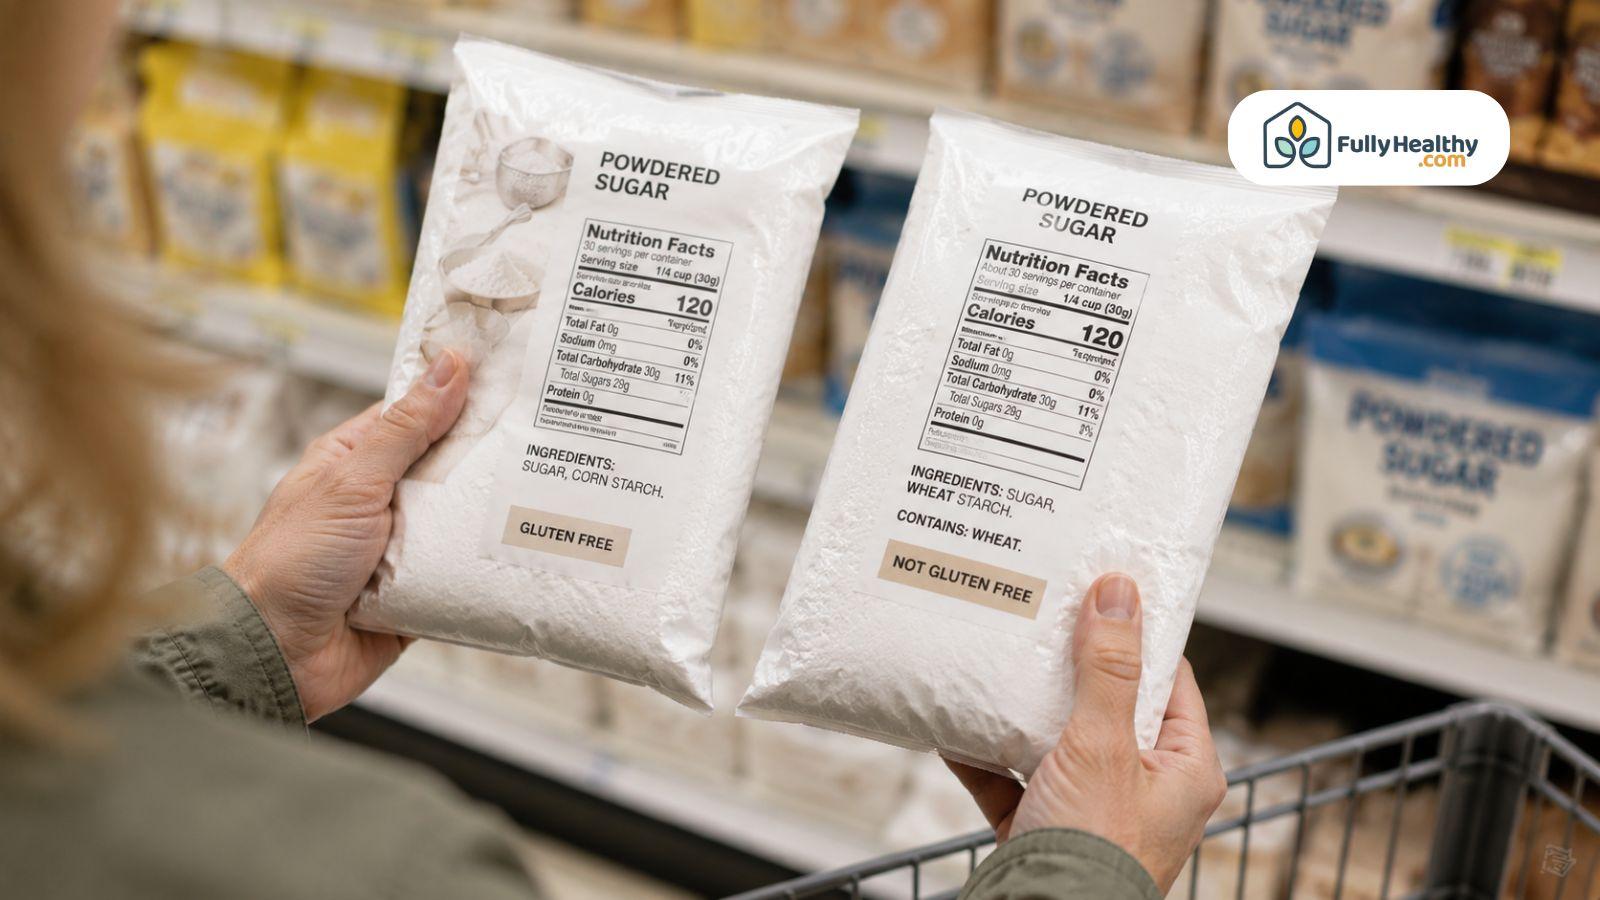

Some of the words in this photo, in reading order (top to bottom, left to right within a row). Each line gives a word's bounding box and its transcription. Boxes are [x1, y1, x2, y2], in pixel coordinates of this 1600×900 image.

[600, 151, 720, 185] POWDERED
[595, 174, 670, 200] SUGAR
[1022, 188, 1149, 228] POWDERED
[587, 223, 662, 249] Nutrition
[667, 237, 715, 258] Facts
[1039, 213, 1117, 243] SUGAR
[581, 254, 616, 270] Serving
[619, 262, 638, 272] size
[656, 266, 671, 277] 1/4
[674, 271, 692, 281] cup
[694, 273, 720, 287] (30g)
[583, 240, 595, 251] 30
[598, 245, 632, 259] servings
[634, 249, 649, 260] per
[651, 252, 692, 267] container
[985, 245, 1070, 276] Nutrition
[1074, 264, 1129, 289] Facts
[573, 282, 635, 304] Calories
[676, 296, 713, 316] 120
[977, 275, 1015, 292] Serving
[1017, 284, 1039, 296] size
[1063, 294, 1079, 305] 1/4
[1082, 299, 1102, 311] cup
[1105, 303, 1133, 319] (30g)
[981, 262, 1007, 276] About
[1008, 268, 1020, 278] 30
[1022, 271, 1059, 287] servings
[1059, 280, 1076, 291] per
[1077, 283, 1121, 300] container
[566, 316, 588, 330] Total
[589, 320, 605, 333] Fat
[607, 323, 618, 336] 0g
[687, 338, 703, 351] 0%
[967, 303, 1035, 330] Calories
[1082, 324, 1124, 349] 120
[557, 350, 578, 364] Total
[580, 354, 642, 375] Carbohydrate
[644, 366, 660, 380] 30g
[674, 373, 695, 387] 11%
[560, 333, 595, 348] Sodium
[598, 338, 617, 354] 0mg
[683, 356, 699, 368] 0%
[957, 338, 982, 354] Total
[983, 343, 1000, 357] Fat
[1002, 348, 1014, 362] 0g
[1094, 370, 1111, 383] 0%
[546, 385, 580, 400] Protein
[582, 390, 594, 404] 0g
[561, 368, 579, 382] Total
[582, 372, 611, 388] Sugars
[946, 372, 970, 388] Total
[972, 377, 1037, 403] Carbohydrate
[1039, 395, 1057, 410] 30g
[1078, 405, 1099, 420] 11%
[991, 364, 1011, 380] 0mg
[1088, 388, 1105, 401] 0%
[934, 407, 970, 425] Protein
[972, 416, 984, 430] 0g
[950, 391, 970, 406] Total
[971, 396, 1003, 414] Sugars
[1348, 391, 1546, 468] POWDERED
[526, 444, 616, 471] INGREDIENTS:
[1382, 441, 1499, 495] SUGAR
[522, 460, 567, 481] SUGAR,
[572, 469, 608, 486] CORN
[611, 478, 664, 499] STARCH.
[911, 465, 1004, 497] INGREDIENTS:
[1007, 489, 1056, 514] SUGAR,
[907, 481, 955, 502] WHEAT
[957, 493, 1013, 518] STARCH.
[520, 521, 575, 543] GLUTEN
[578, 533, 614, 551] FREE
[897, 509, 969, 537] CONTAINS:
[972, 528, 1021, 552] WHEAT.
[892, 555, 926, 574] NOT
[929, 565, 990, 591] GLUTEN
[993, 582, 1032, 604] FREE
